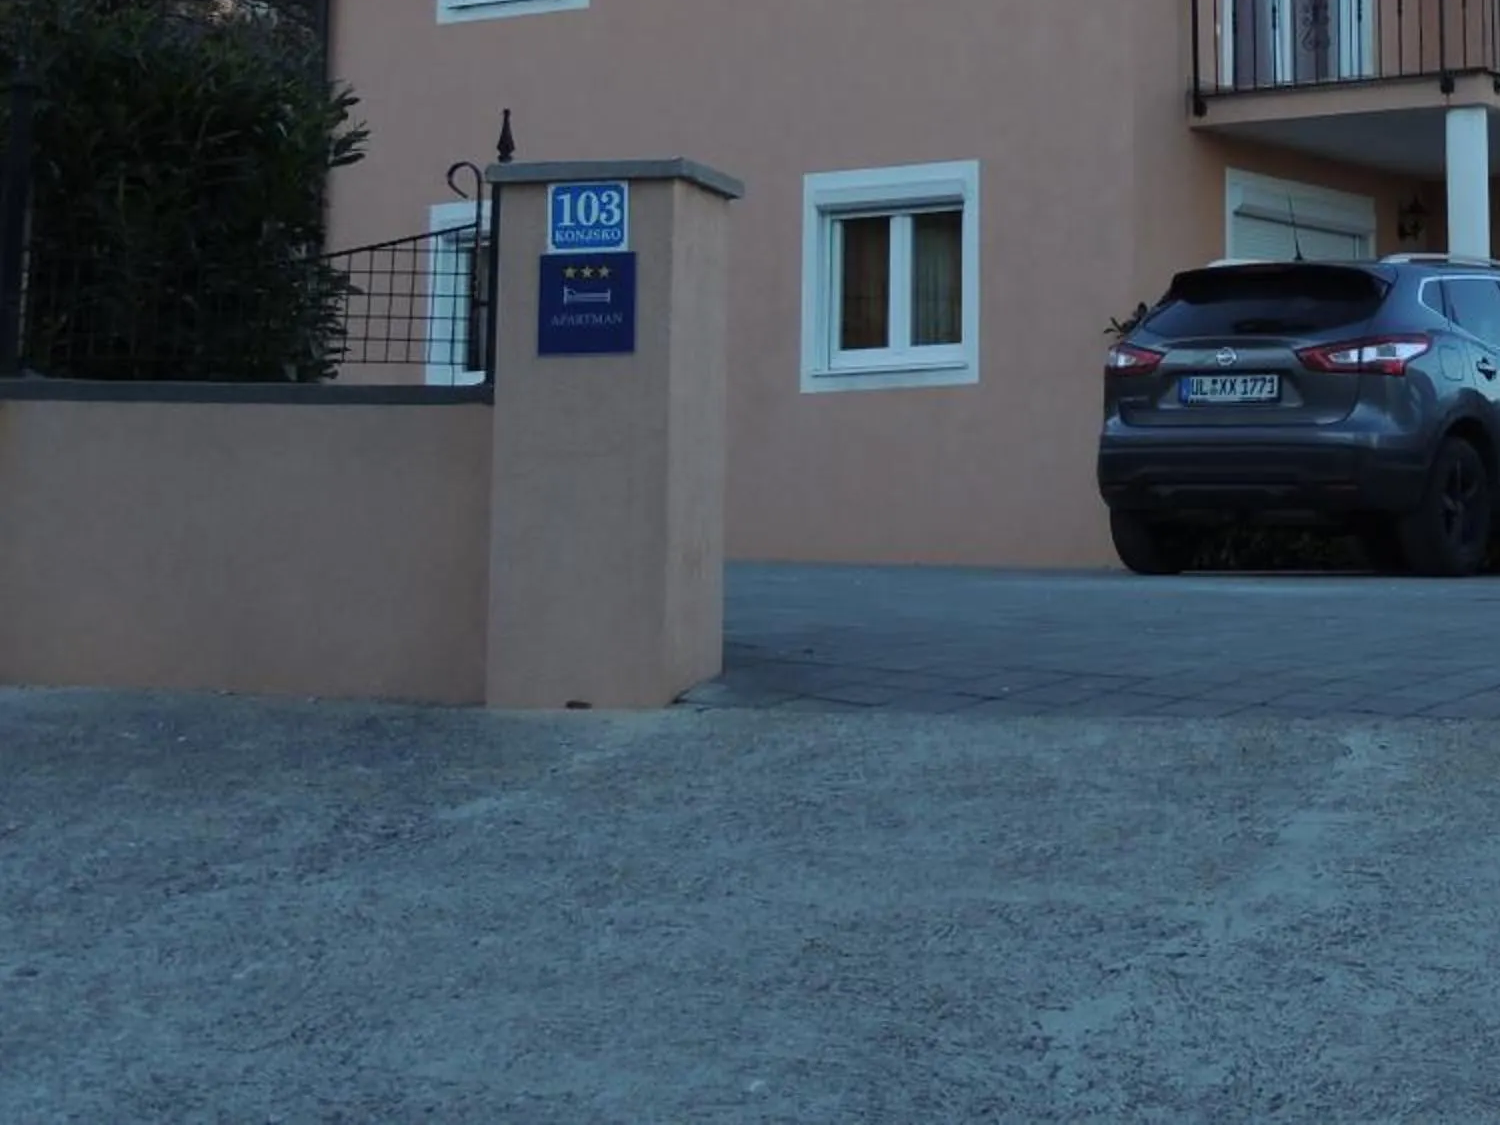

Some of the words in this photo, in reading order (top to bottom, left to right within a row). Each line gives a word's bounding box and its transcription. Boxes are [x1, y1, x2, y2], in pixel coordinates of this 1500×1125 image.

[556, 190, 621, 226] 103
[555, 227, 621, 242] KONJSKO
[550, 311, 623, 327] APARTMAN
